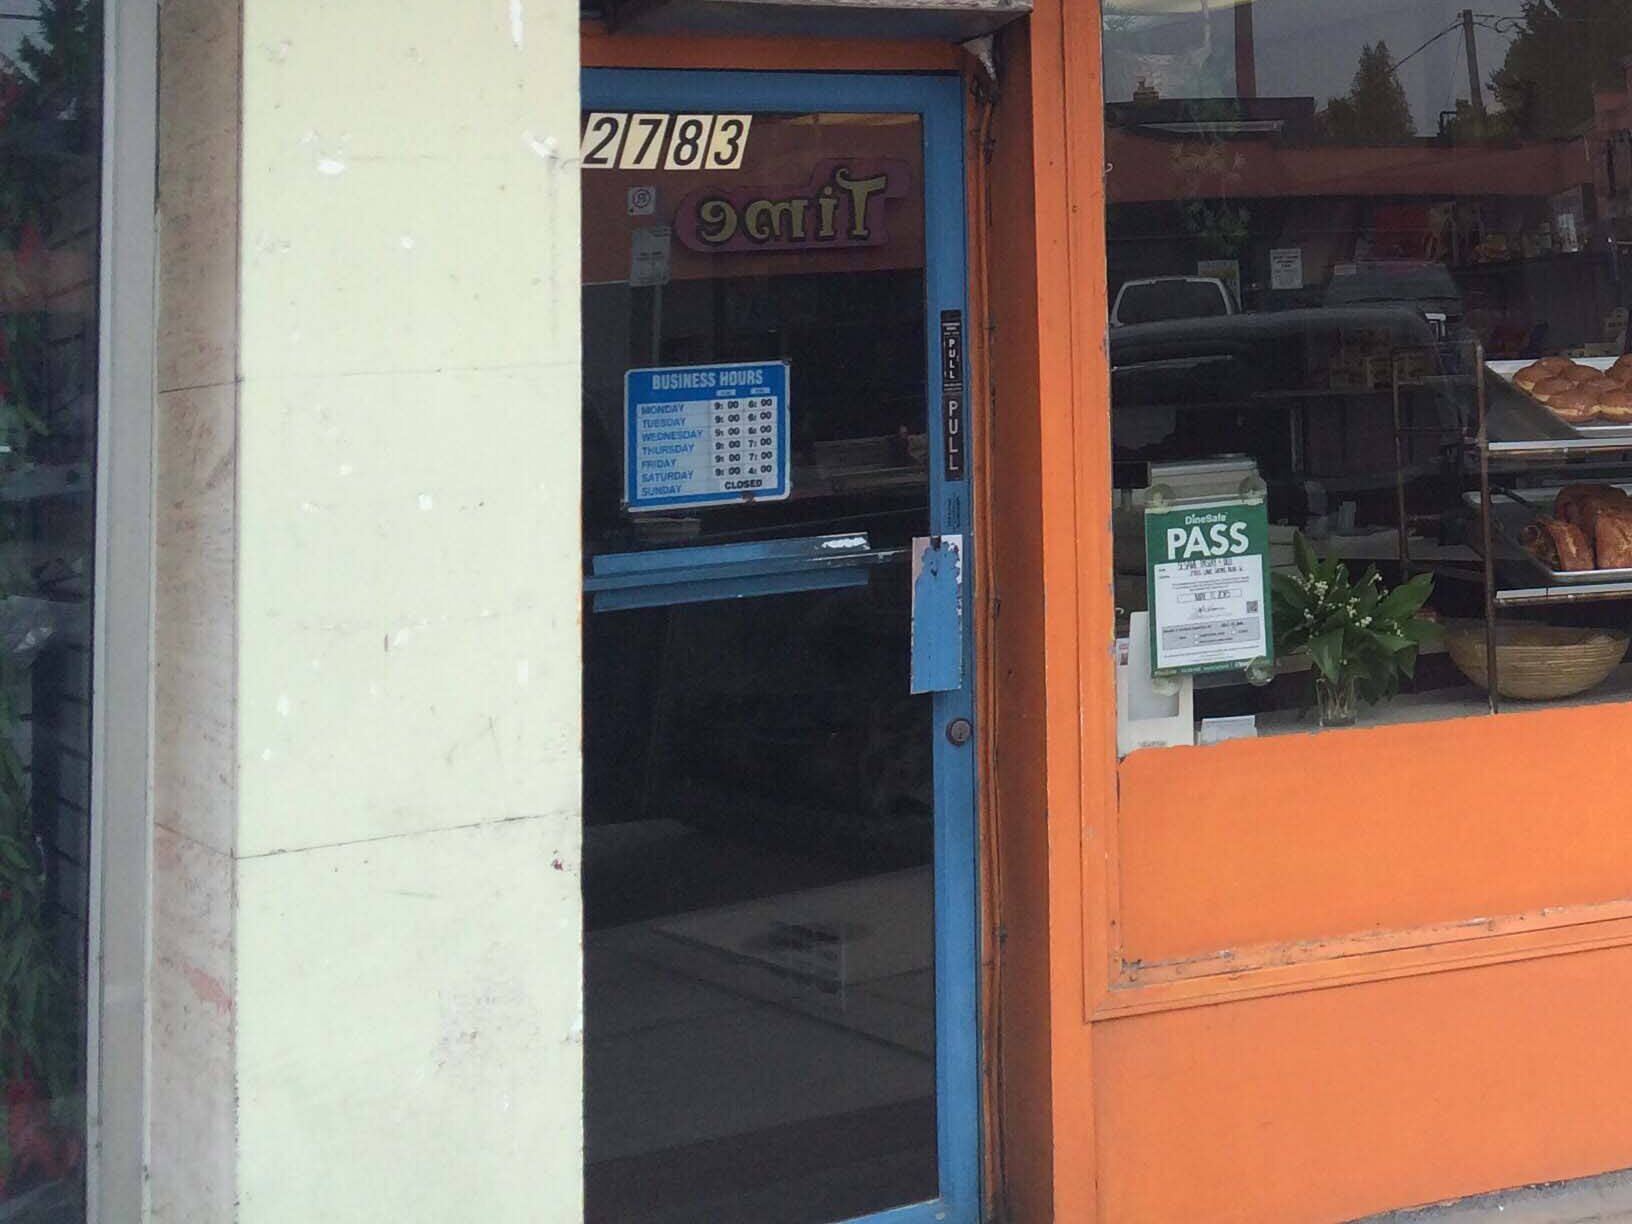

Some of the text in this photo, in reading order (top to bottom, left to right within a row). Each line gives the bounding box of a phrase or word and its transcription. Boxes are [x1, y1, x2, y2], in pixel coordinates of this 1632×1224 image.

[582, 116, 744, 166] 2783
[948, 339, 957, 379] PULL
[652, 369, 763, 390] BUSINESS HOURS
[641, 403, 684, 415] MONDAY
[642, 417, 686, 429] TUESDAY
[642, 429, 703, 442] WEDNESDAY
[949, 401, 959, 470] PULL
[642, 444, 694, 456] THURSDAY
[641, 458, 677, 470] FRIDAY
[641, 470, 694, 483] SATURDAY
[641, 479, 763, 497] SUNDAY CLOSED
[1185, 513, 1227, 525] DineSafe
[1167, 522, 1249, 560] PASS
